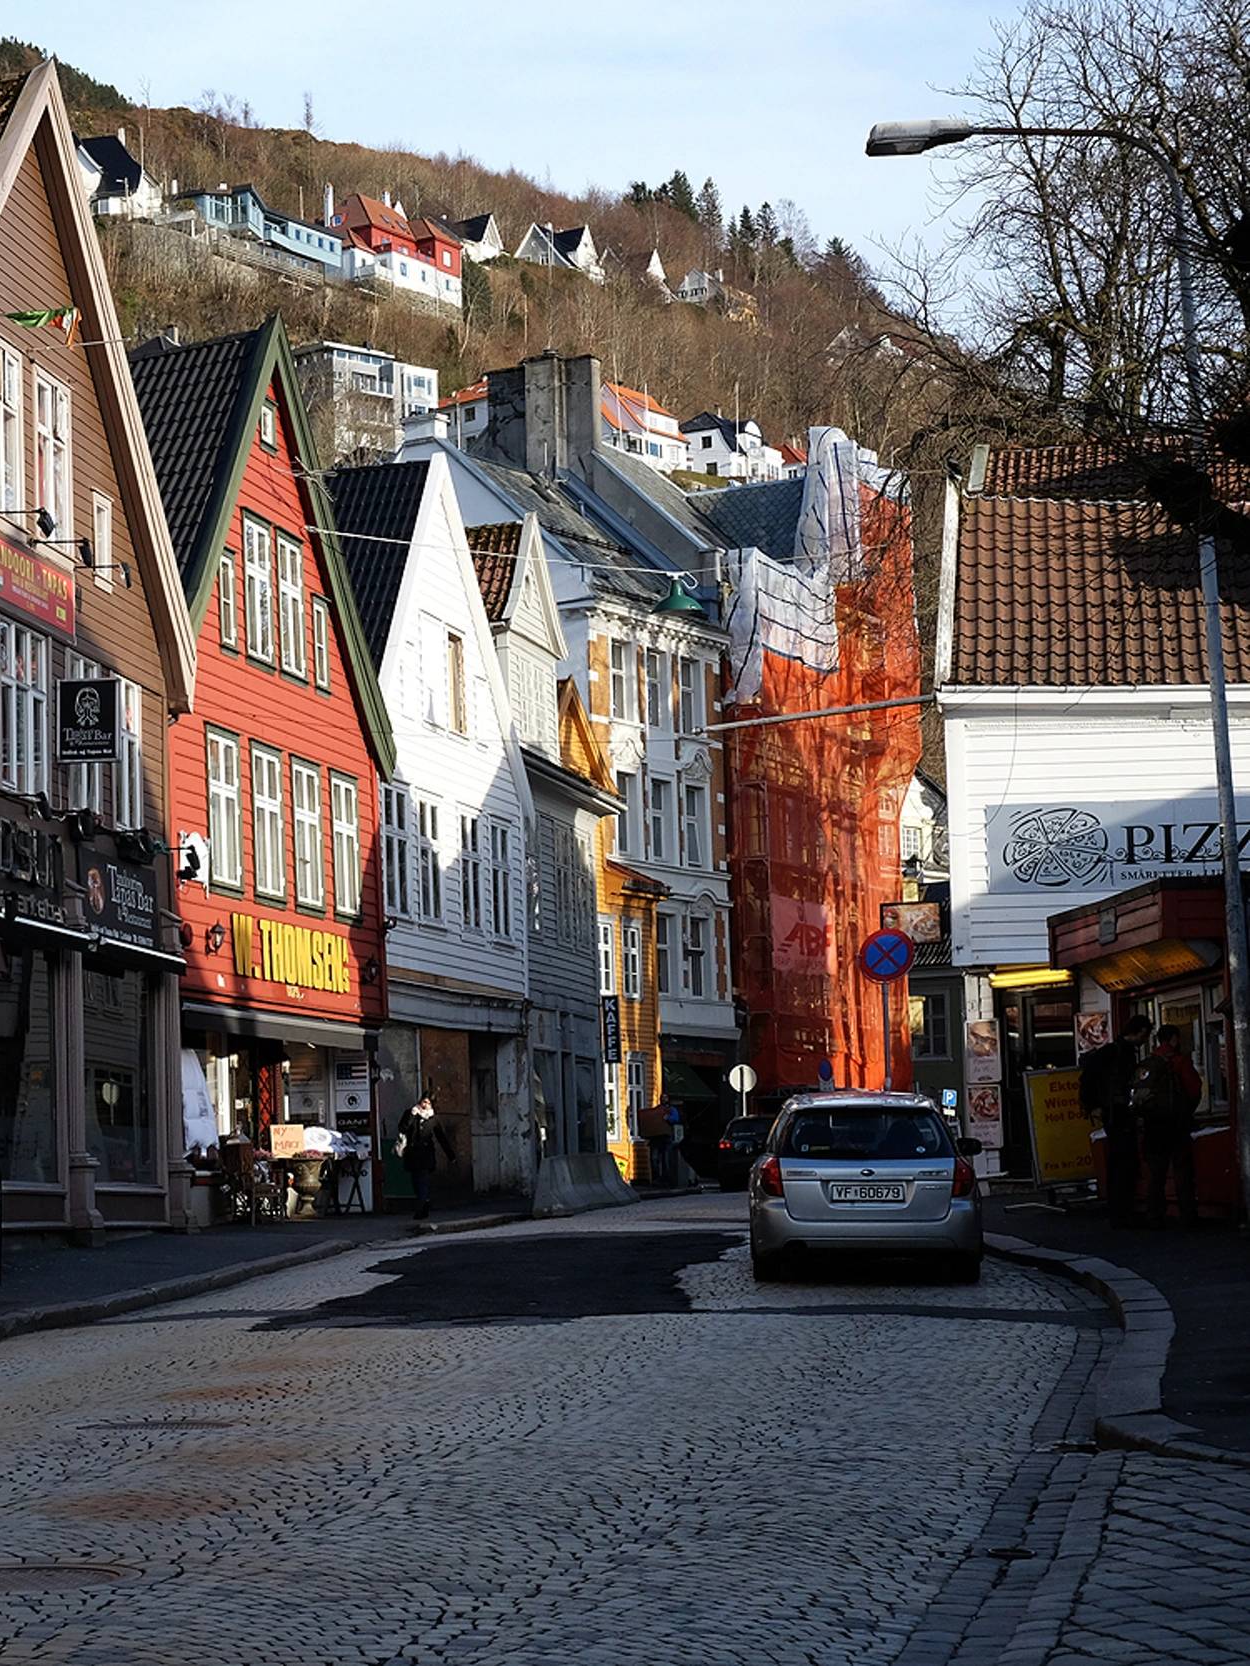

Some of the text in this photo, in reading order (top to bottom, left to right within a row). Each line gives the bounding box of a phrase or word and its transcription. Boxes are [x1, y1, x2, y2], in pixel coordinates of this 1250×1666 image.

[42, 568, 68, 602] TAPAS
[95, 729, 112, 740] Bar
[1120, 822, 1250, 866] PIZ
[259, 919, 344, 993] THOMSEN
[605, 999, 618, 1060] KAFFE
[1044, 1097, 1080, 1109] Wien
[337, 1118, 368, 1126] GANT
[1045, 1112, 1064, 1122] Hot
[859, 1187, 901, 1199] 60679
